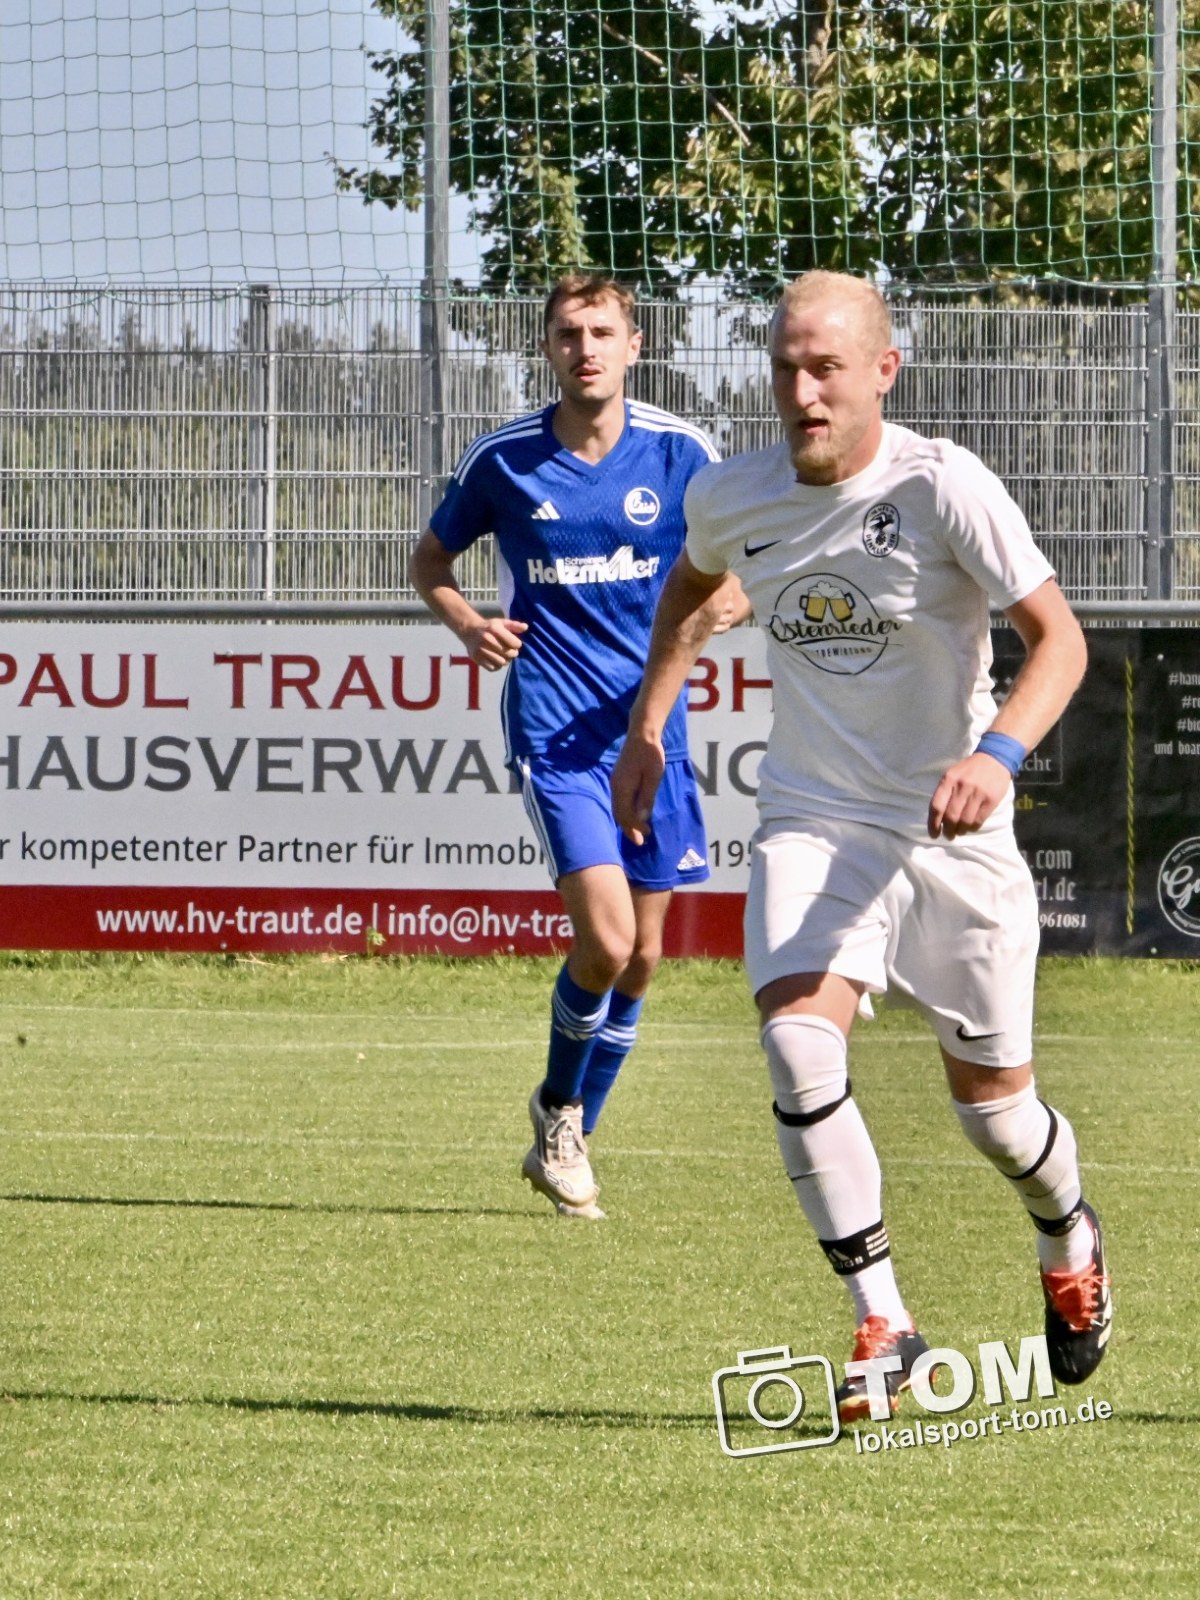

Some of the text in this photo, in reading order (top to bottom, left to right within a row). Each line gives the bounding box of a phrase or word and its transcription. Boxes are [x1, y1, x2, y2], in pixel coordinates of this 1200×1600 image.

[213, 652, 484, 712] TRAUT
[686, 656, 775, 713] BH
[1154, 741, 1173, 755] und
[21, 831, 228, 869] kompetenter
[238, 834, 358, 863] Partner
[367, 835, 414, 864] für
[96, 903, 363, 936] www.hv-traut.de
[387, 904, 575, 943] info@hv-tra
